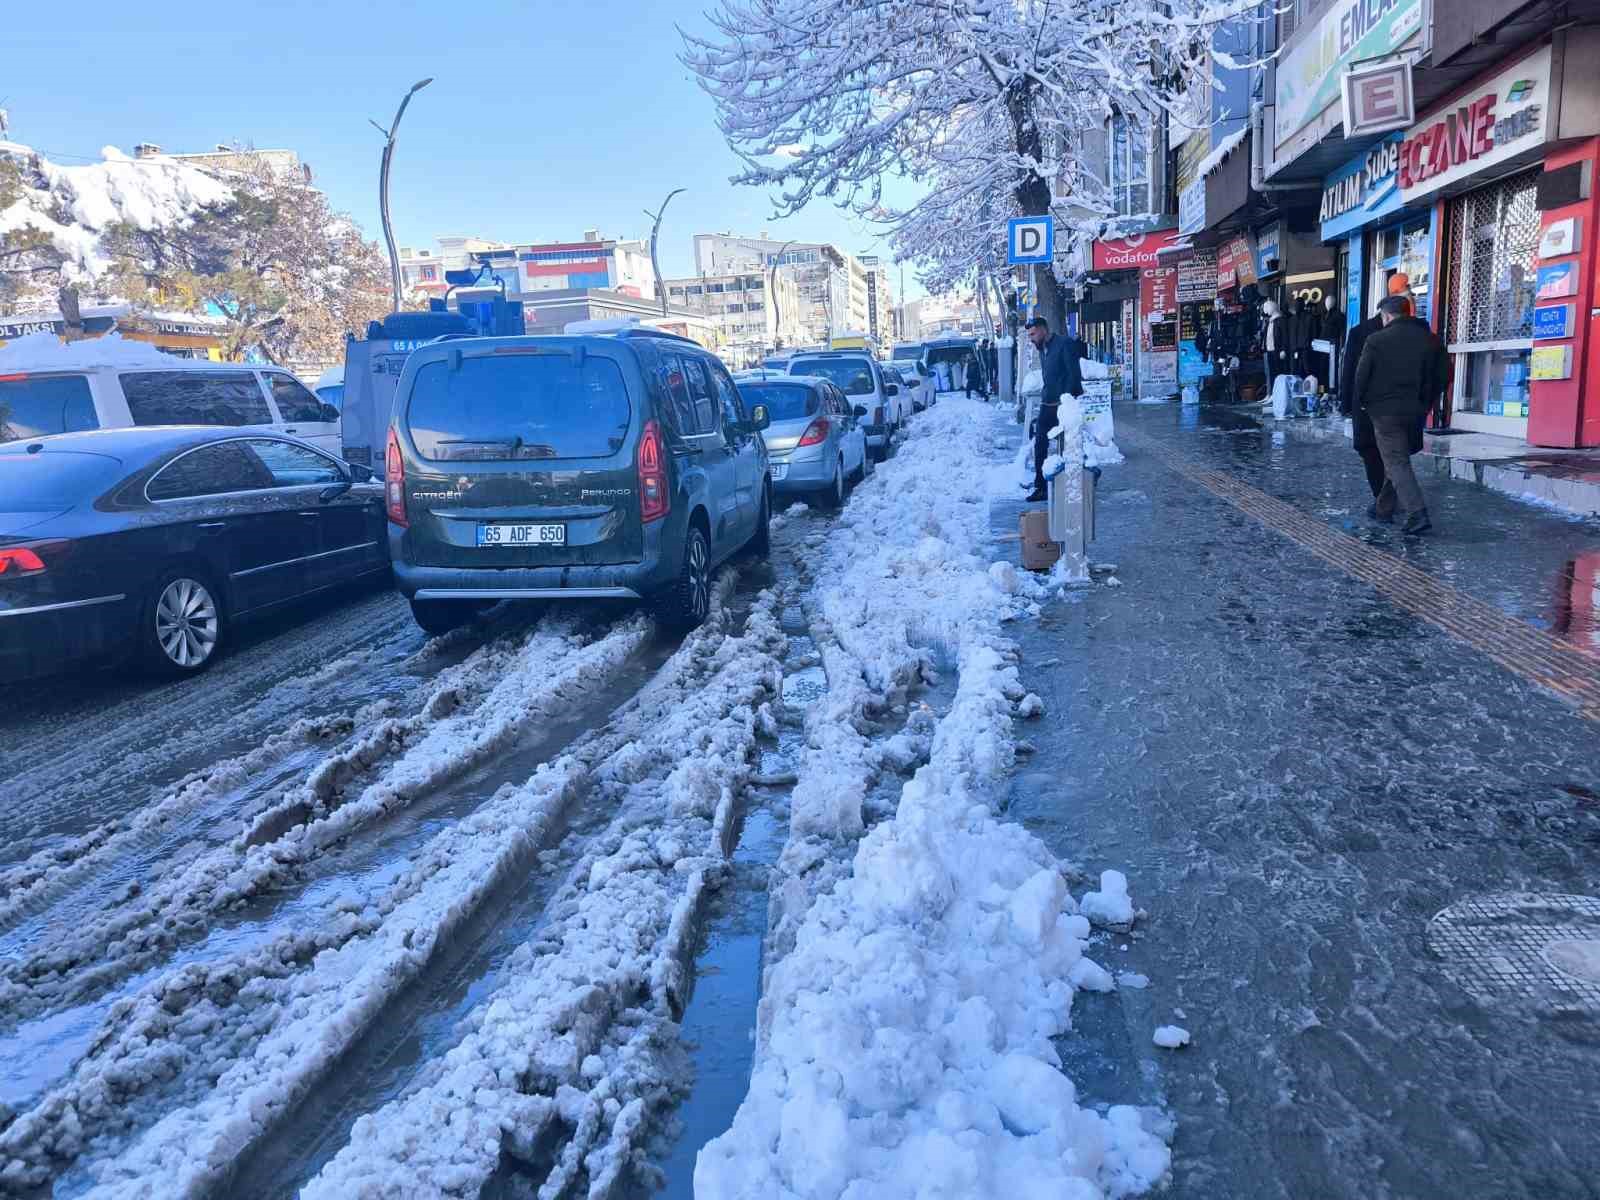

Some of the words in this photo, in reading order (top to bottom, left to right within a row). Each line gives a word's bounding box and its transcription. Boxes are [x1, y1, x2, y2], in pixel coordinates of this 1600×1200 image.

[1361, 76, 1397, 121] E
[1398, 94, 1497, 190] ECZANE
[1319, 171, 1360, 223] ATILIM
[1021, 228, 1040, 252] D
[1105, 251, 1158, 265] vodafon
[1144, 268, 1175, 278] CEP
[485, 526, 501, 542] 65
[510, 526, 533, 542] ADF
[540, 525, 564, 541] 650
